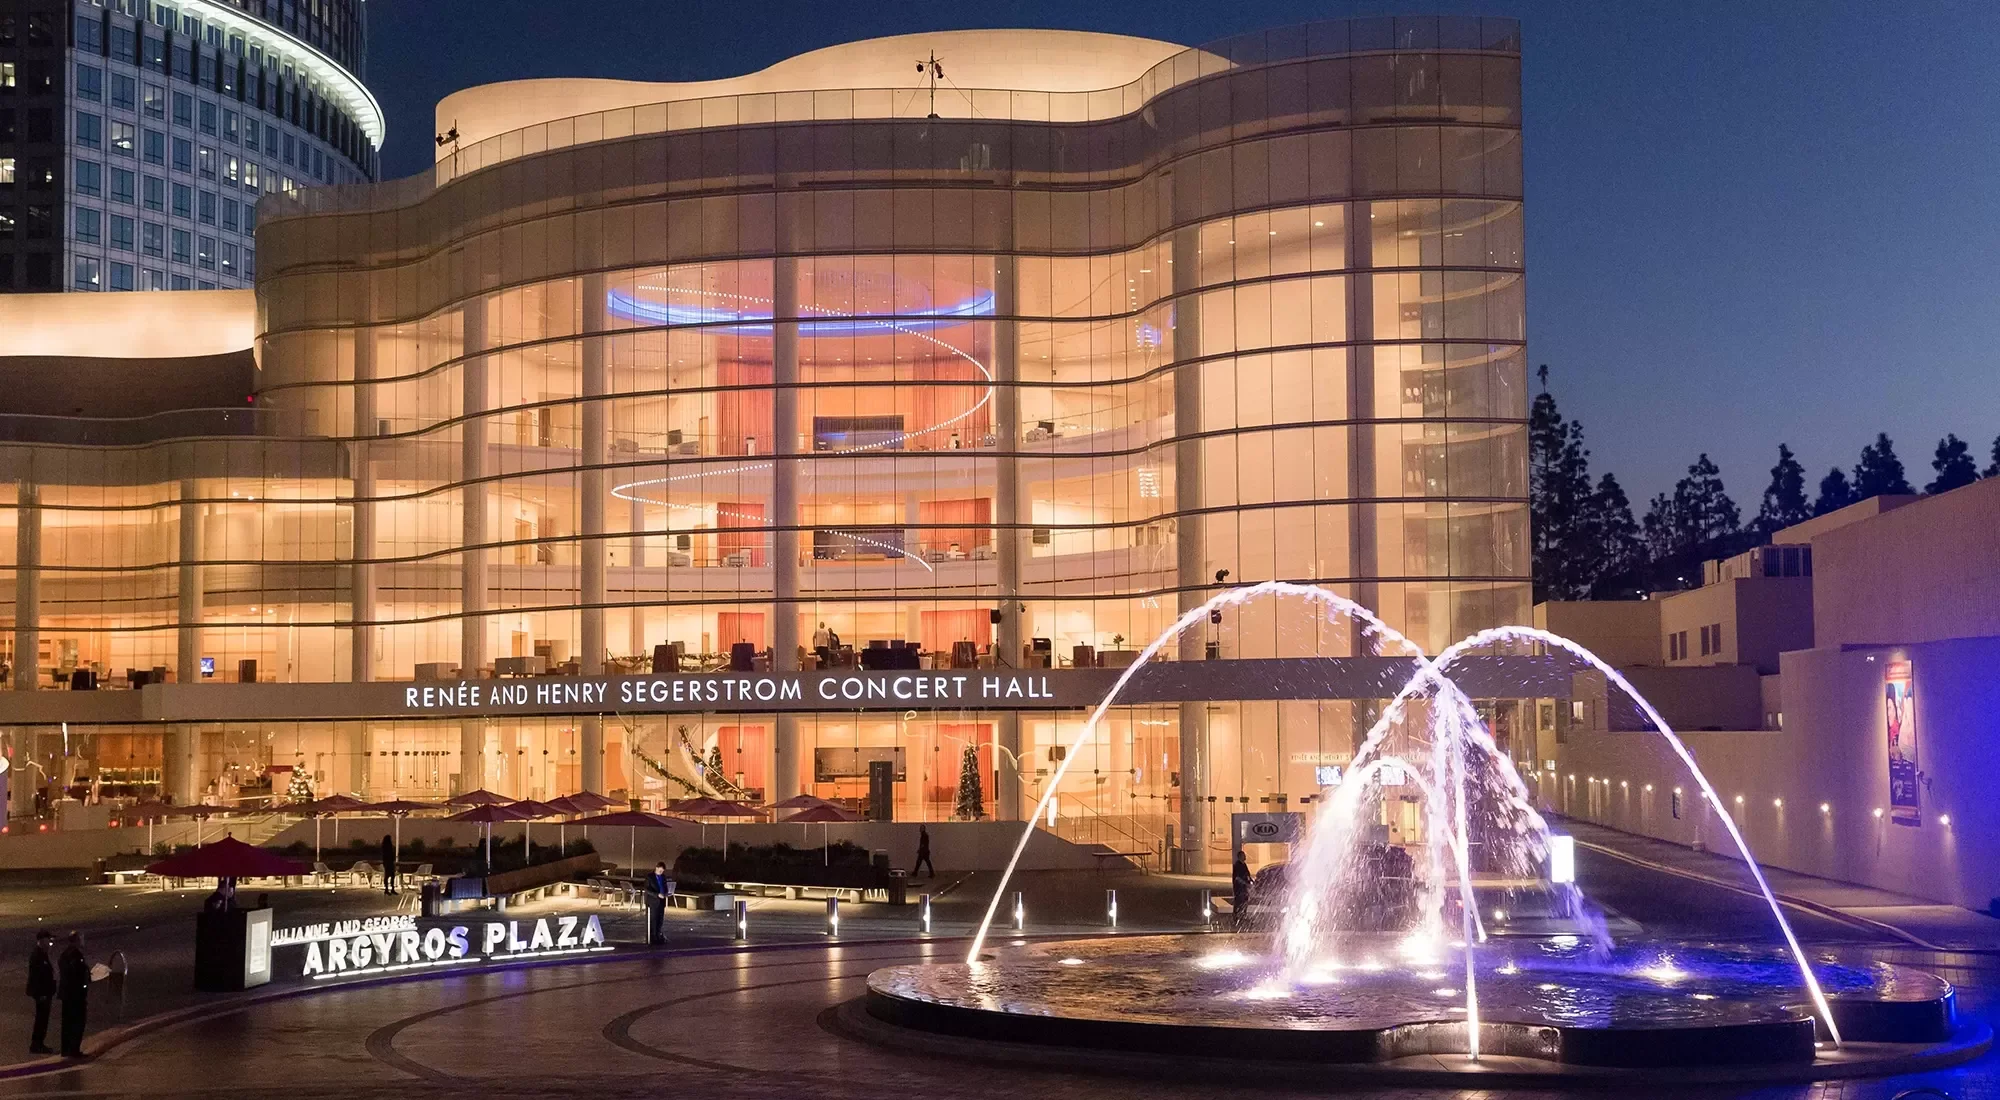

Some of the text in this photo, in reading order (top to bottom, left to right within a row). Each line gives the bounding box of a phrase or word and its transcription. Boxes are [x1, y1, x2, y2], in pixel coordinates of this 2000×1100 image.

[406, 676, 1055, 708] RENÉE AND HENRY SEGERSTROM CONCERT HALL
[333, 919, 361, 936] AND
[364, 914, 417, 932] GEORGE
[302, 926, 469, 977] ARGYROS
[484, 914, 605, 954] PLAZA
